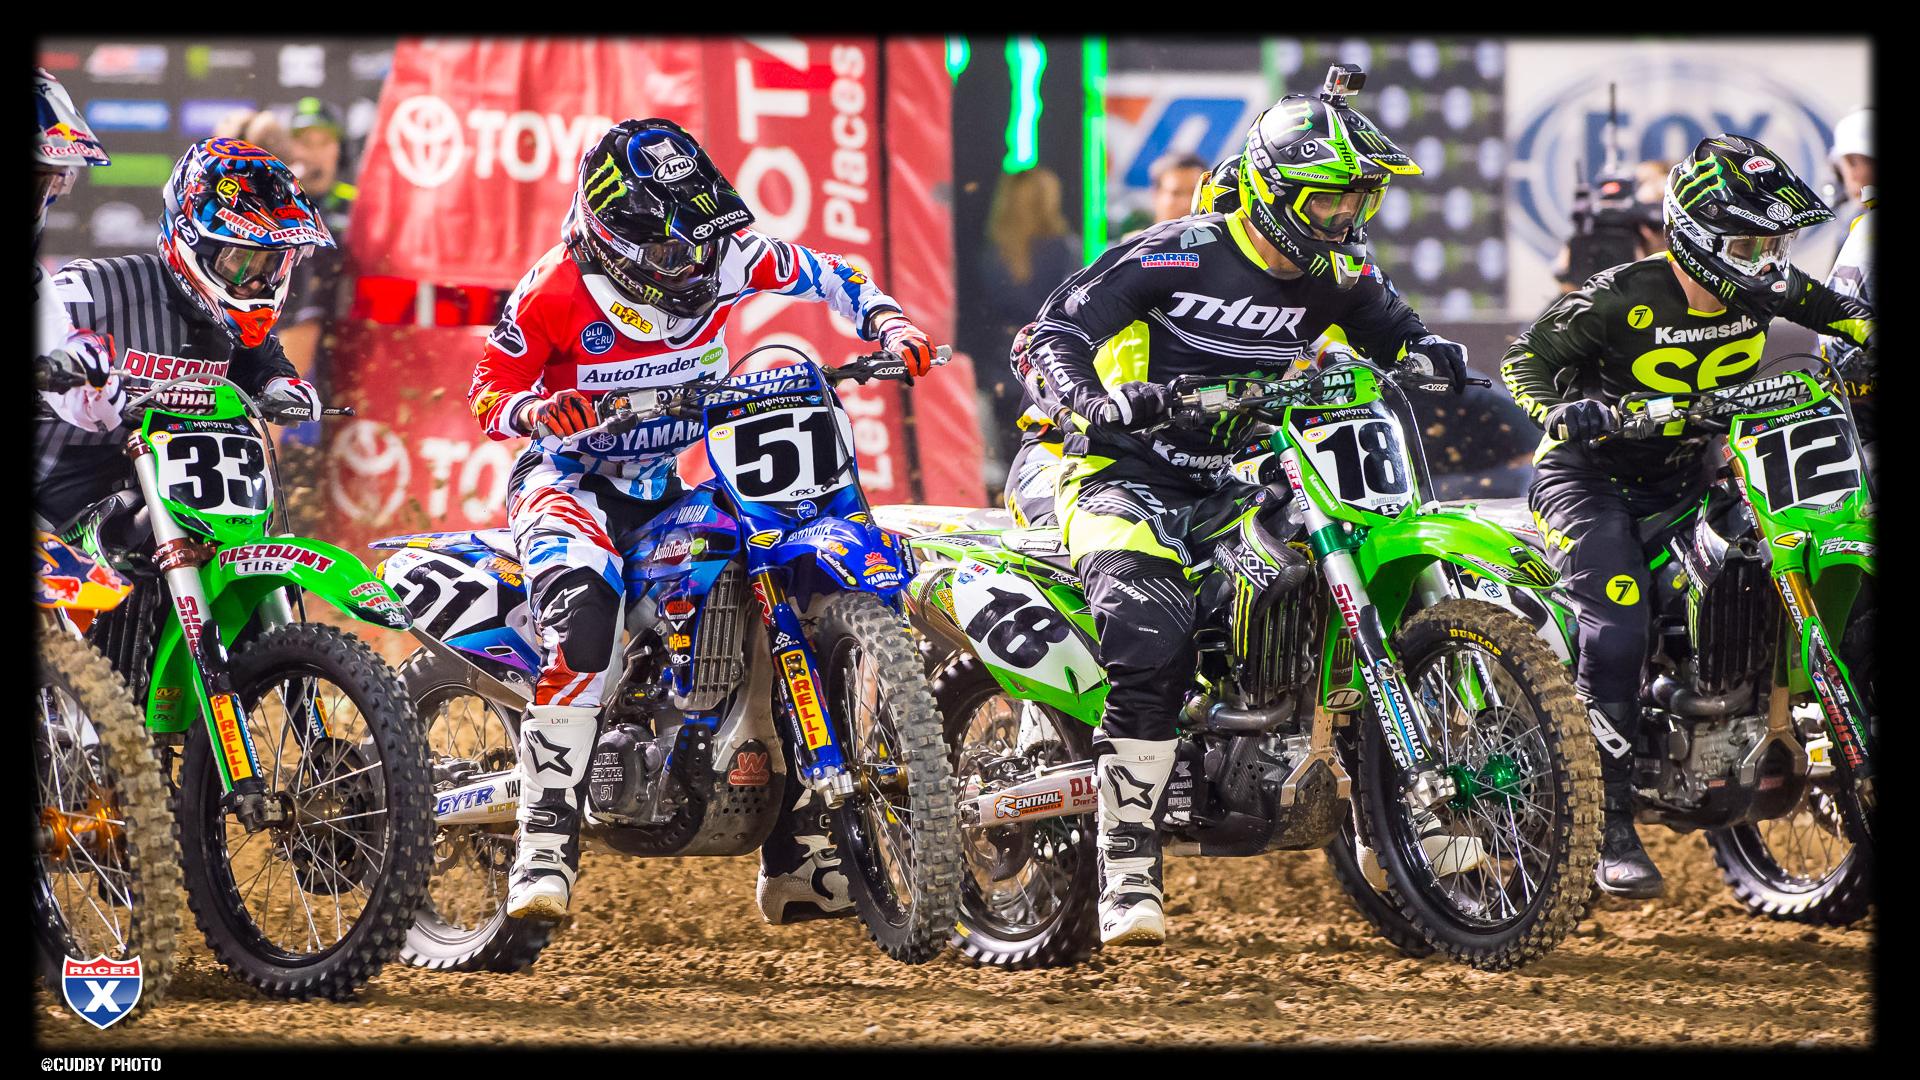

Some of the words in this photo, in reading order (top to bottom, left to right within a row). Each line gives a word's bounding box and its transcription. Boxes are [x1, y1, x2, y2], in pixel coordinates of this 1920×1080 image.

[43, 145, 77, 159] Red
[823, 44, 871, 244] Places
[659, 157, 692, 181] Arai
[1748, 159, 1771, 172] BELL
[709, 209, 748, 227] TOYOTA
[1782, 209, 1833, 227] MONSTER
[1141, 253, 1199, 263] PARTS
[1166, 291, 1307, 340] THOR
[1633, 308, 1648, 327] 7
[757, 395, 804, 408] MONSTER
[1332, 408, 1372, 417] MONSTER
[193, 420, 234, 430] MONSTER
[1776, 408, 1817, 424] MONSTER
[735, 411, 840, 498] 51
[1316, 421, 1408, 502] 18
[166, 434, 268, 510] 33
[1755, 418, 1861, 514] 12
[676, 505, 709, 525] YAMAHA
[219, 544, 332, 573] DISCOUNT
[653, 541, 691, 561] AutoTrader
[243, 561, 286, 572] TIRE
[865, 572, 905, 585] YAMAHA
[391, 559, 489, 641] 51
[1614, 580, 1634, 602] 7
[965, 586, 1071, 669] 18
[1449, 628, 1503, 656] DUNLOP
[1361, 664, 1411, 770] DUNLOP
[1822, 696, 1853, 743] LUCAS
[213, 696, 241, 778] PIRELLI
[437, 785, 495, 816] GYTR
[600, 784, 614, 801] 51
